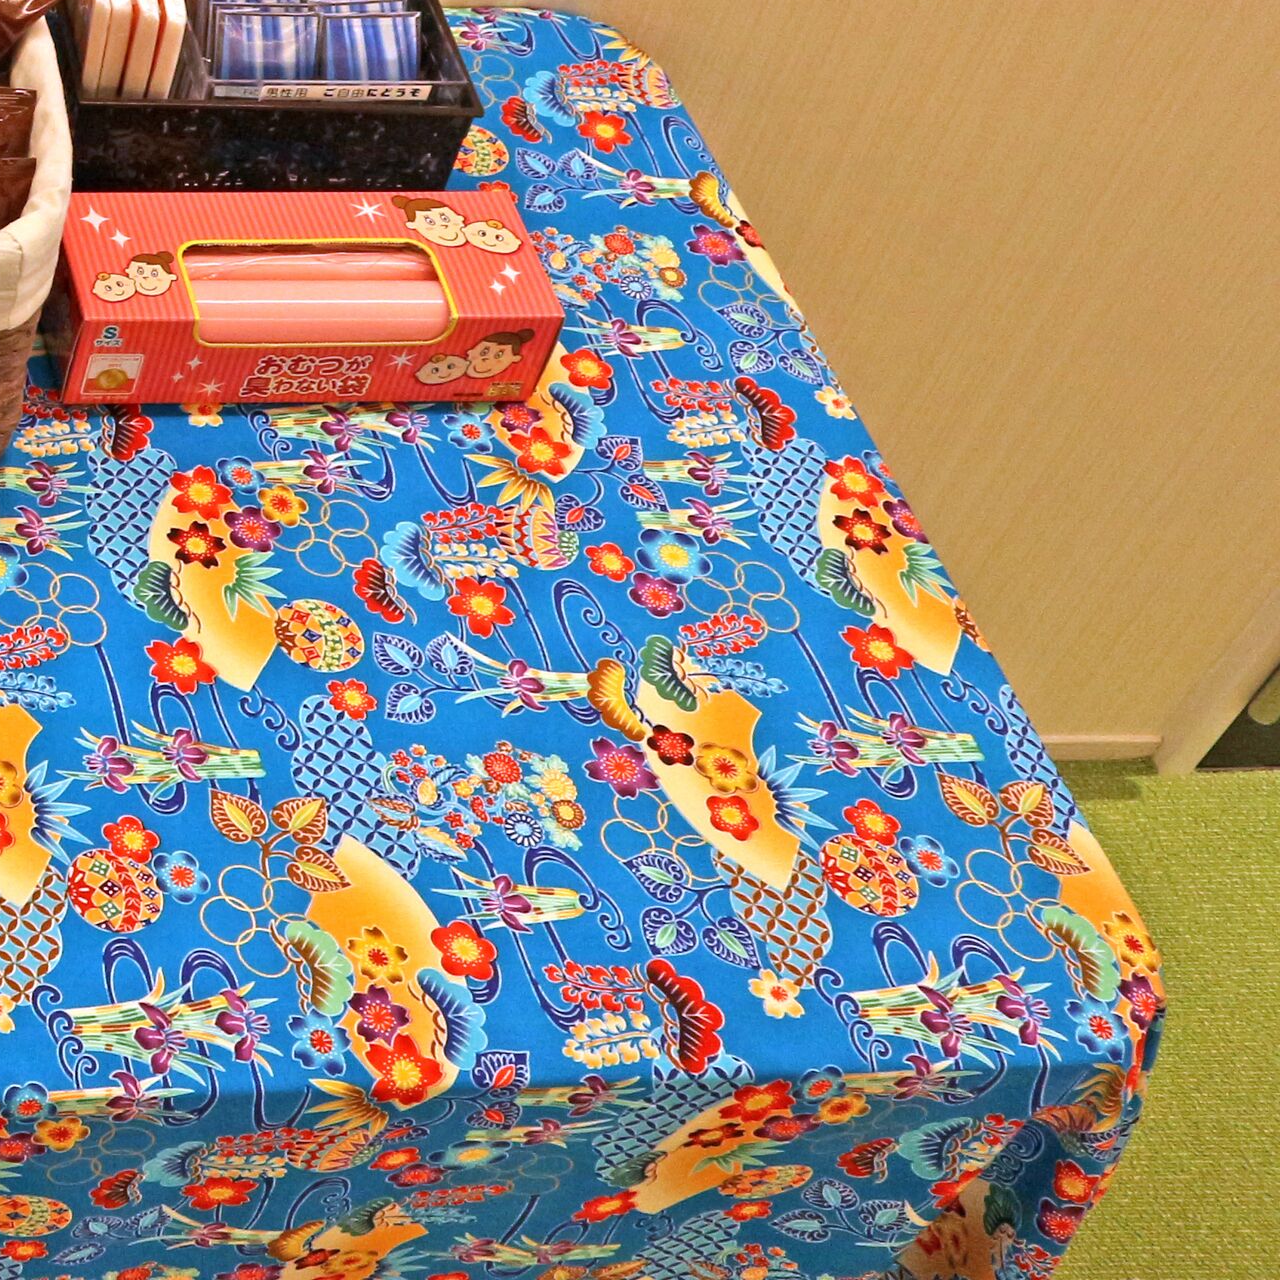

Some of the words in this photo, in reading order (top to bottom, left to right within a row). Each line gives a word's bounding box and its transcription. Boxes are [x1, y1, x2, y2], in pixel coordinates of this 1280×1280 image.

[102, 325, 119, 340] S
[94, 339, 123, 347] サイズ
[255, 354, 373, 377] おむつが
[239, 373, 371, 397] 臭わない袋
